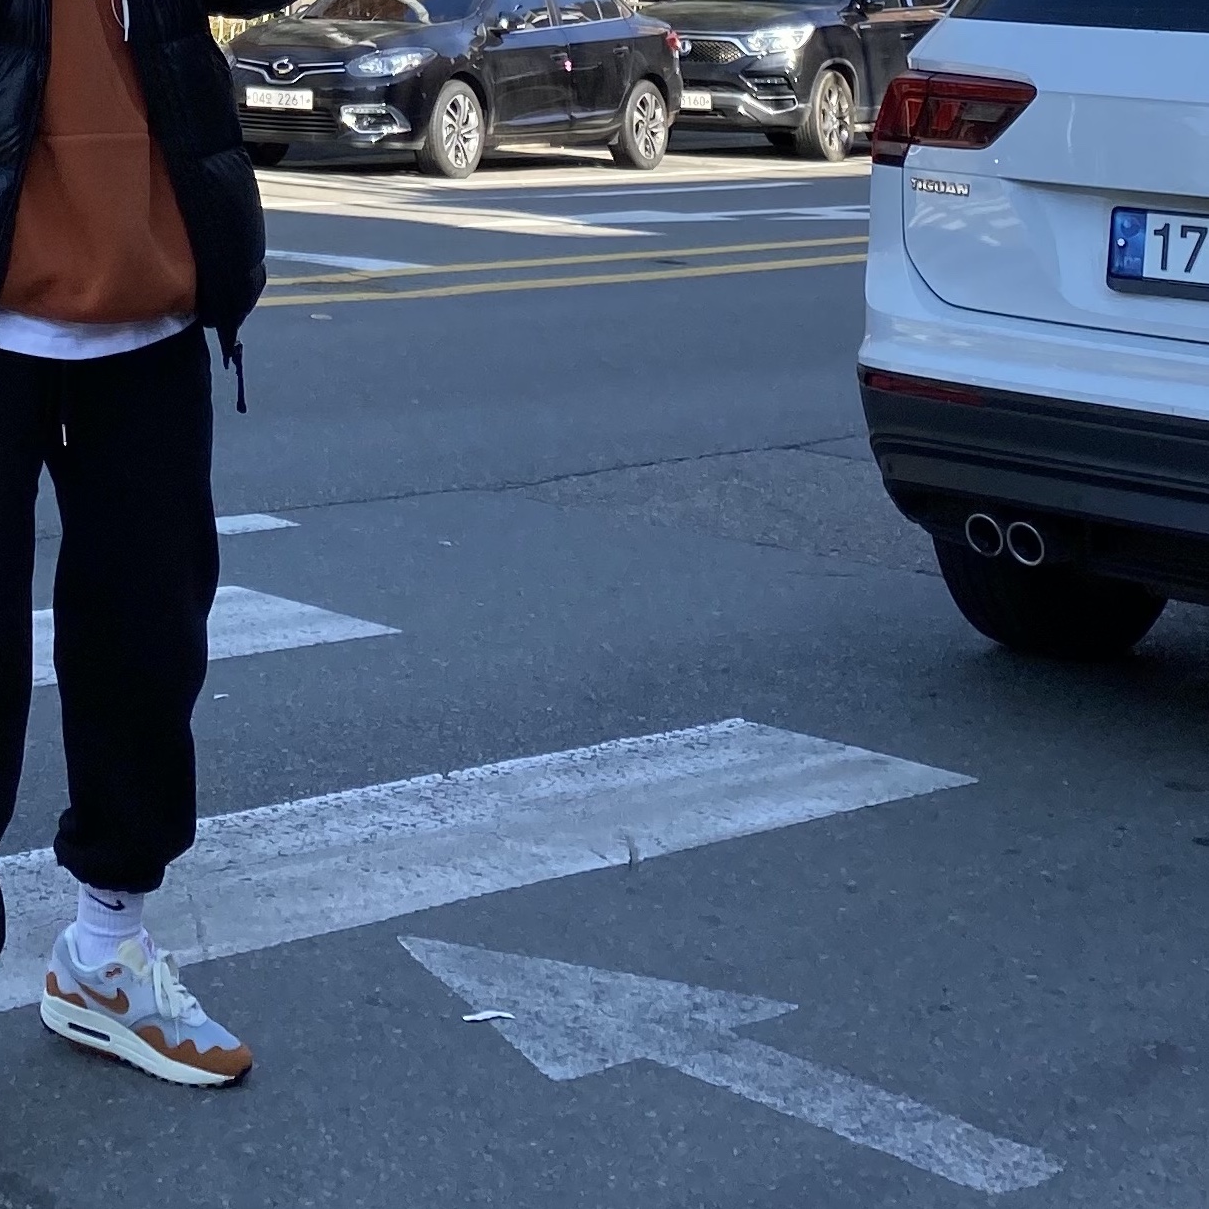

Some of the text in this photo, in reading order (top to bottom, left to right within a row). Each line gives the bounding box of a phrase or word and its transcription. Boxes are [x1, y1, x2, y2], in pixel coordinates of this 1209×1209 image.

[277, 92, 304, 106] 2261
[910, 177, 970, 197] TIGUAN
[1153, 222, 1209, 274] 17
